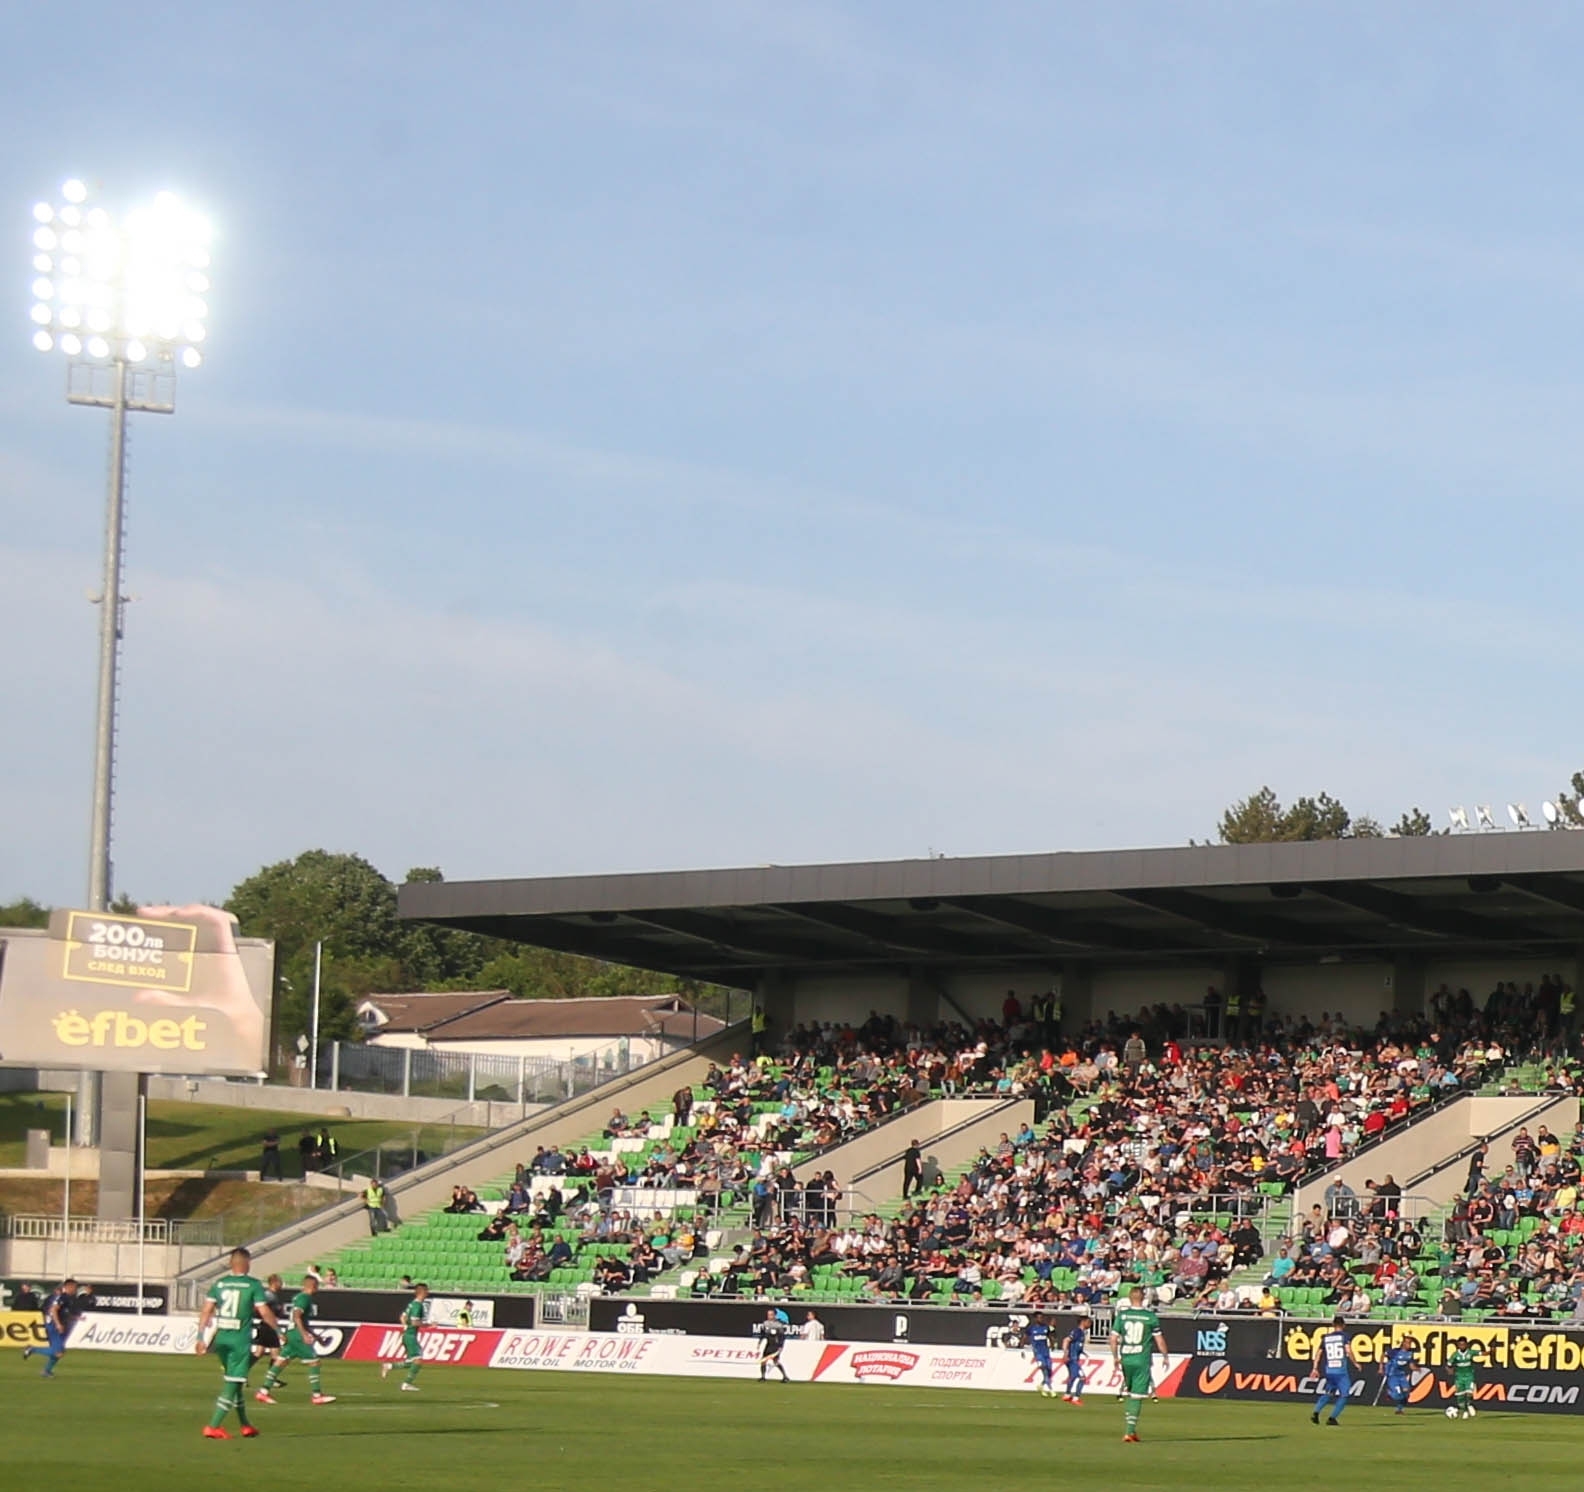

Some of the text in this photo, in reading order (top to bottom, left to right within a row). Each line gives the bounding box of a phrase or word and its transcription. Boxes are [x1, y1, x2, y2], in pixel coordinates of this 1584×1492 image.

[93, 943, 164, 965] БОНУС
[54, 1010, 207, 1050] efbet
[221, 1289, 240, 1318] 21
[0, 1319, 50, 1343] et
[81, 1323, 171, 1346] Autotrade
[1124, 1322, 1144, 1344] 30
[1197, 1330, 1227, 1351] NBS
[377, 1330, 476, 1362] WNBET
[504, 1336, 653, 1360] ROWE ROWE
[1285, 1325, 1392, 1364] efet
[1325, 1342, 1344, 1360] 86
[497, 1356, 561, 1368] MOTOR OIL
[573, 1358, 638, 1370] MOTOR OIL
[1438, 1381, 1580, 1404] VVACOM
